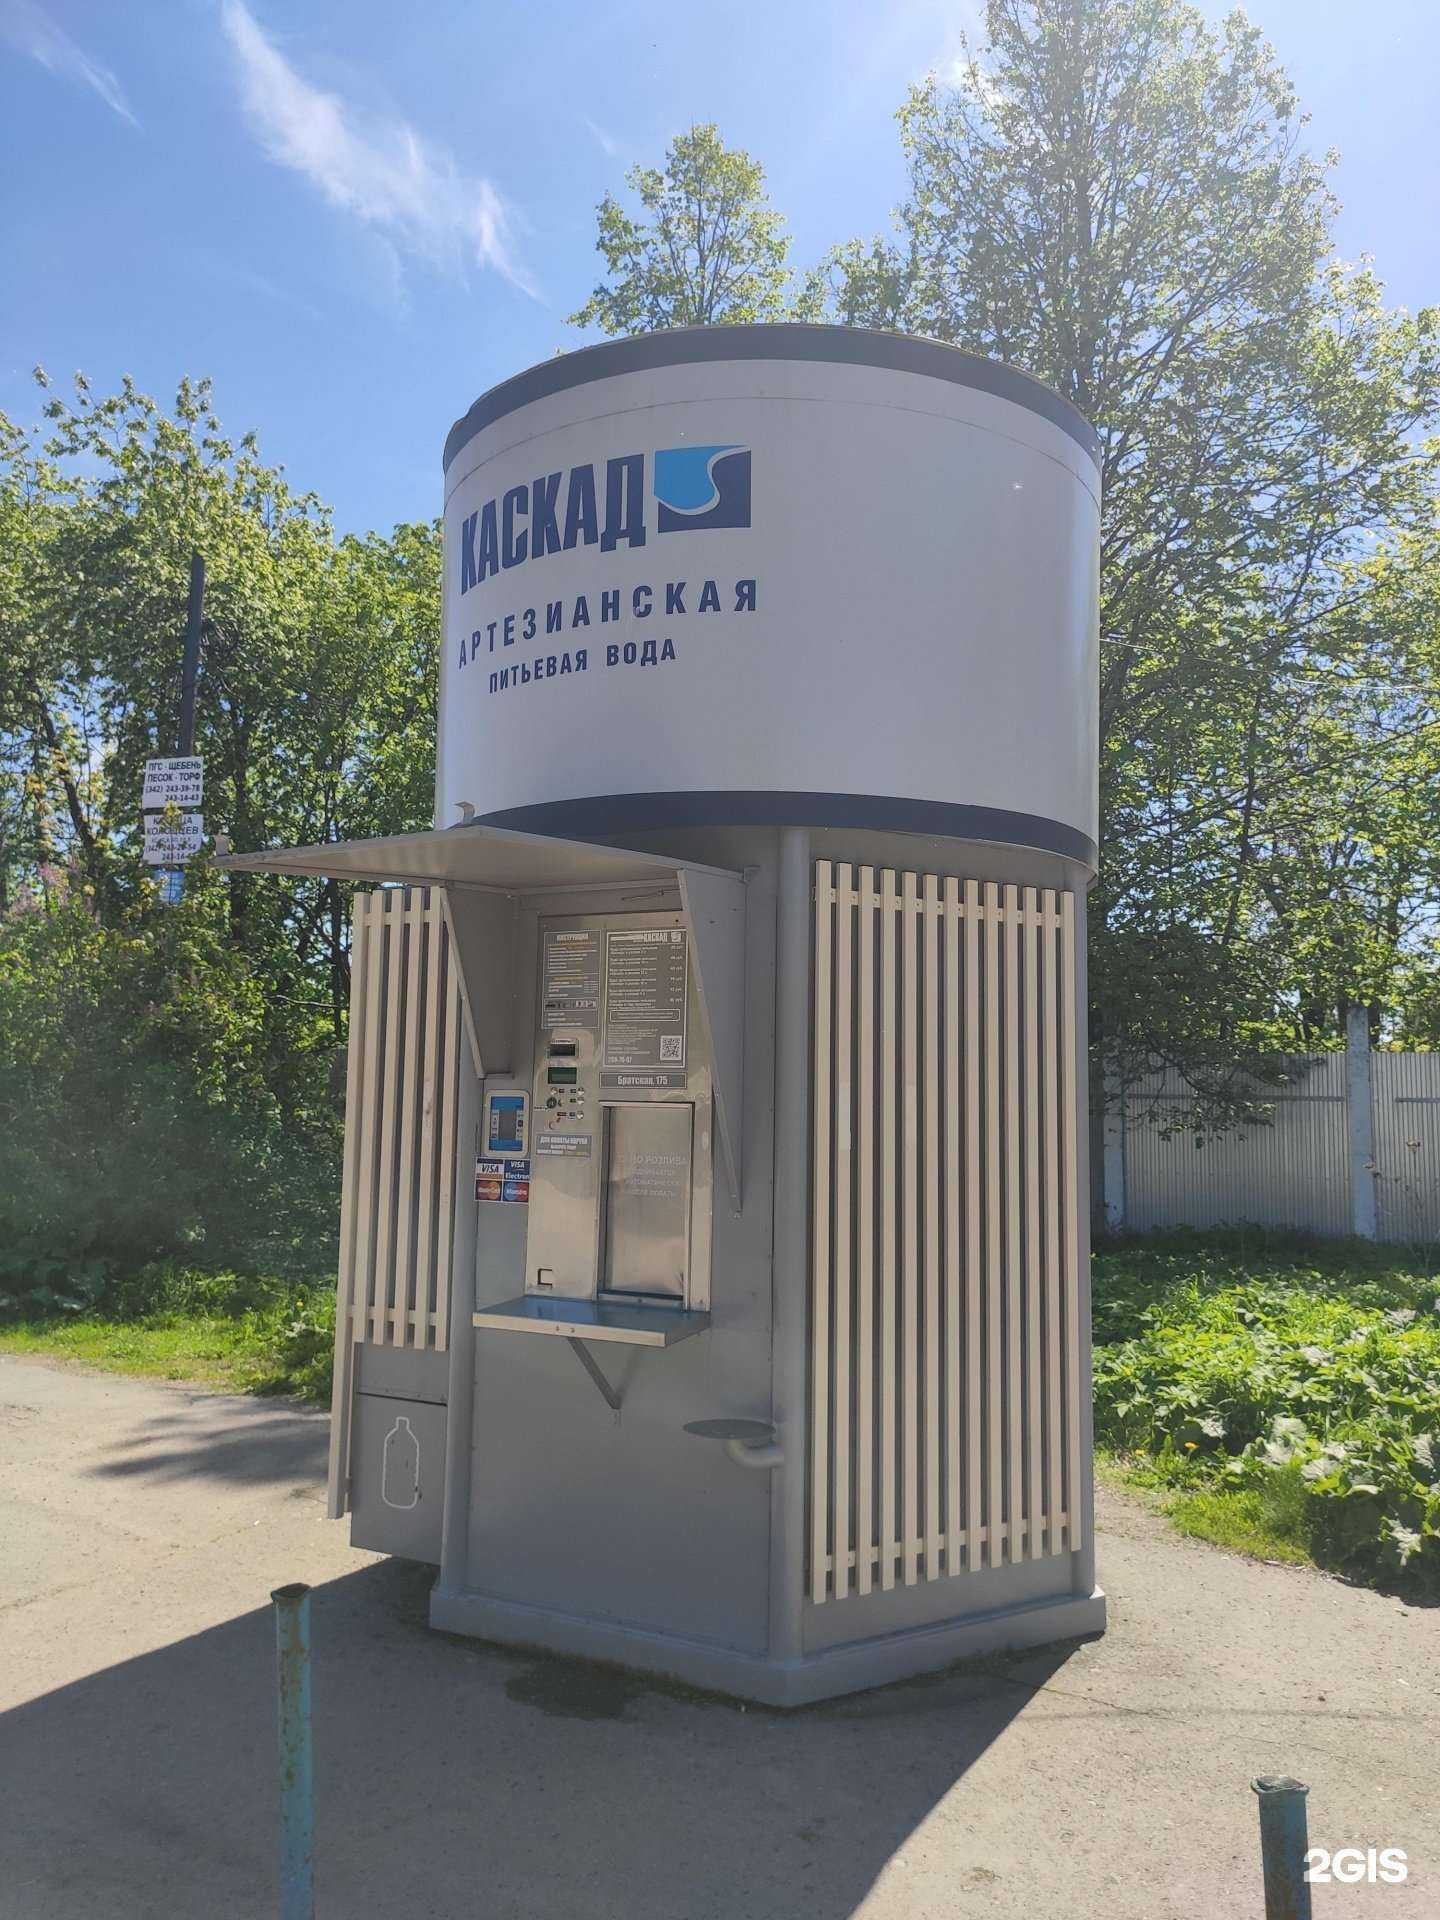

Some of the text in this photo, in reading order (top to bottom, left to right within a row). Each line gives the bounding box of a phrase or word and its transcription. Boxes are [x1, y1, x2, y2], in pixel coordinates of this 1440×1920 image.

[461, 453, 646, 596] КАСКАД
[459, 579, 756, 669] АРТЕЗИАНСКАЯ
[489, 638, 676, 694] ПИТЬЕВАЯ ВОДА
[169, 761, 201, 770] ЩЕБЕНЬ
[148, 773, 173, 782] ПЕСОК
[180, 772, 201, 781] ТОРФ
[655, 1075, 668, 1085] 175
[482, 1164, 499, 1173] VISA
[505, 1171, 529, 1180] Electron
